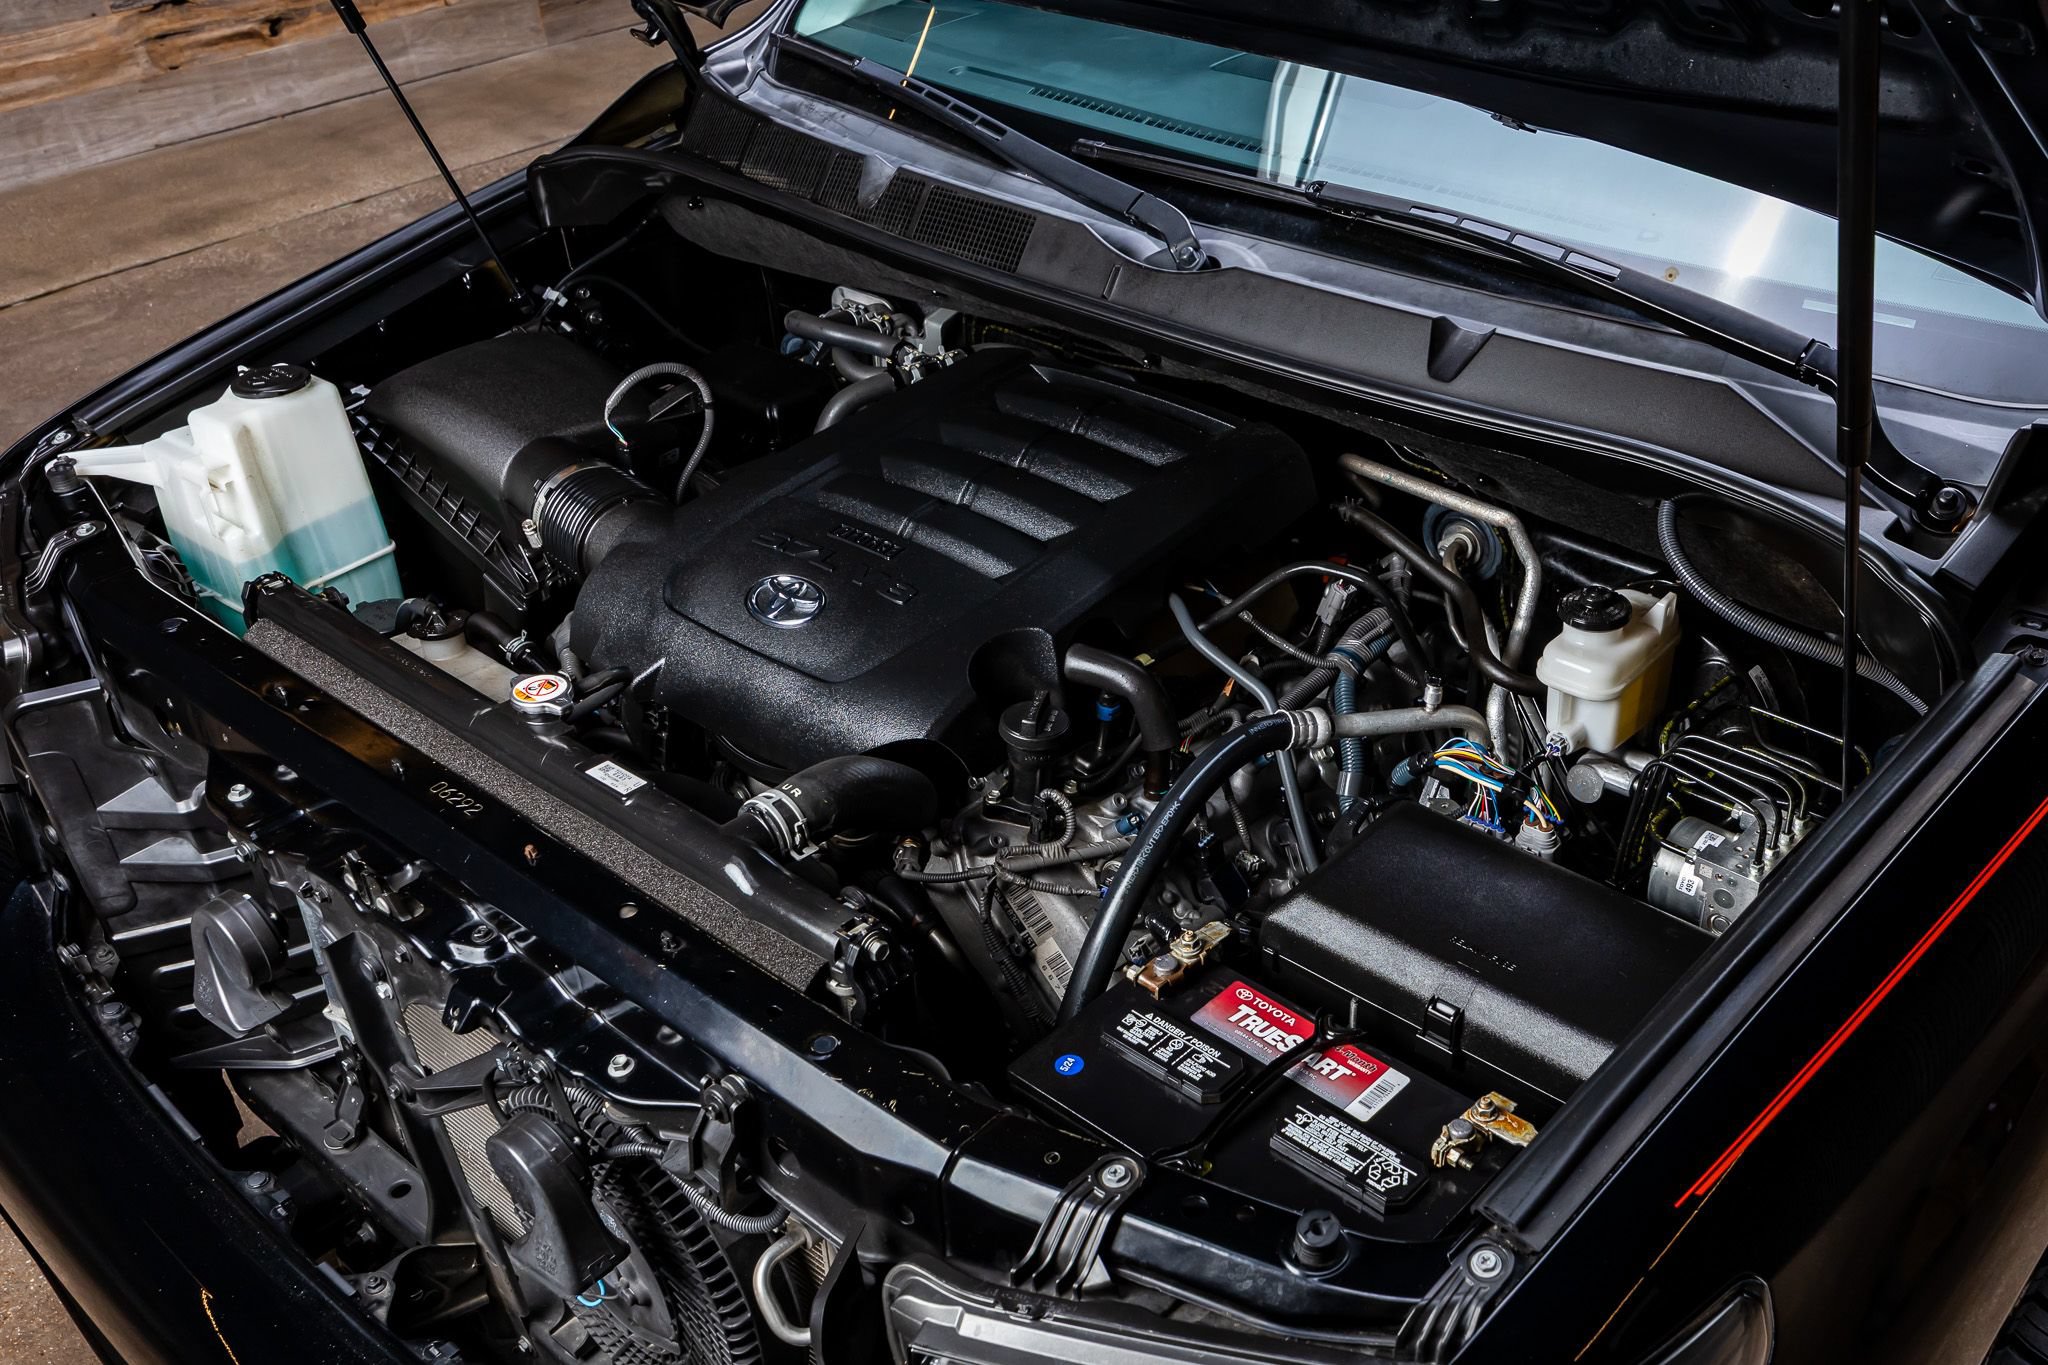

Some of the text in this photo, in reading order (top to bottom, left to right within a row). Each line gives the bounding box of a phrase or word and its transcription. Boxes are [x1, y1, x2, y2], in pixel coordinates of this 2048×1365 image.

[430, 781, 484, 816] 06292
[1253, 997, 1296, 1027] TOYOTA
[1153, 1016, 1186, 1037] DANGER
[1190, 1037, 1221, 1058] POISON
[1059, 1057, 1076, 1072] 5/24
